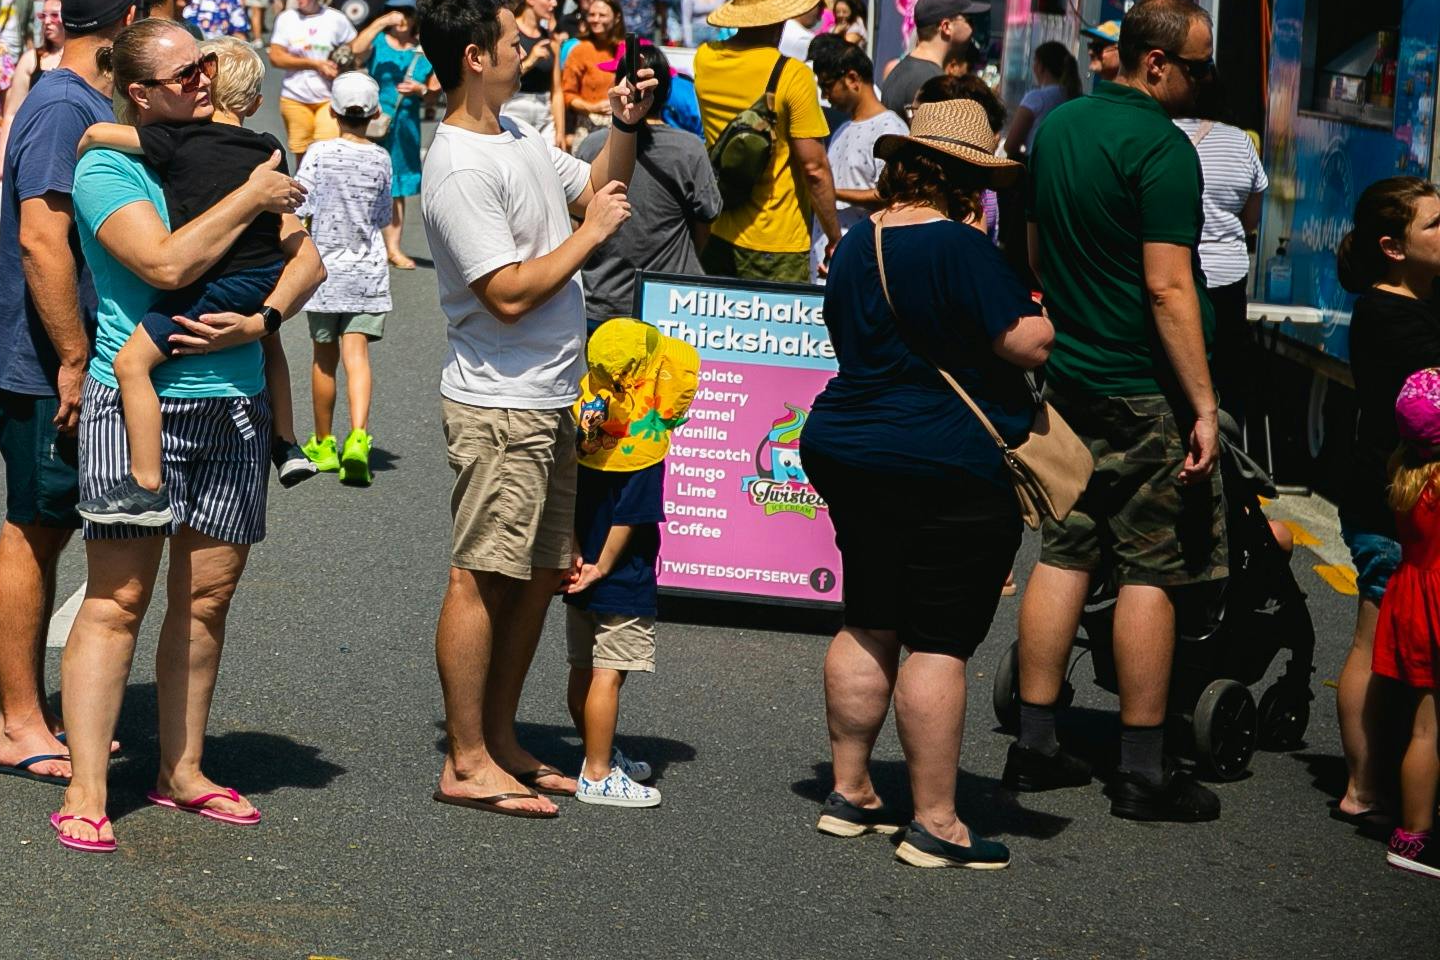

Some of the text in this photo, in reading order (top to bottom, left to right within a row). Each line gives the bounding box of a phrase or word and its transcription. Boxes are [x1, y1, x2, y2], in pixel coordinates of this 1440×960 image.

[657, 320, 836, 358] Thickshake
[684, 408, 736, 422] ramel
[673, 424, 728, 441] Vanilla
[670, 462, 726, 483] Mango
[677, 482, 717, 499] Lime
[664, 501, 728, 519] Banana
[667, 521, 722, 538] Coffee
[663, 560, 809, 585] TWISTEDSOFTSERVE
